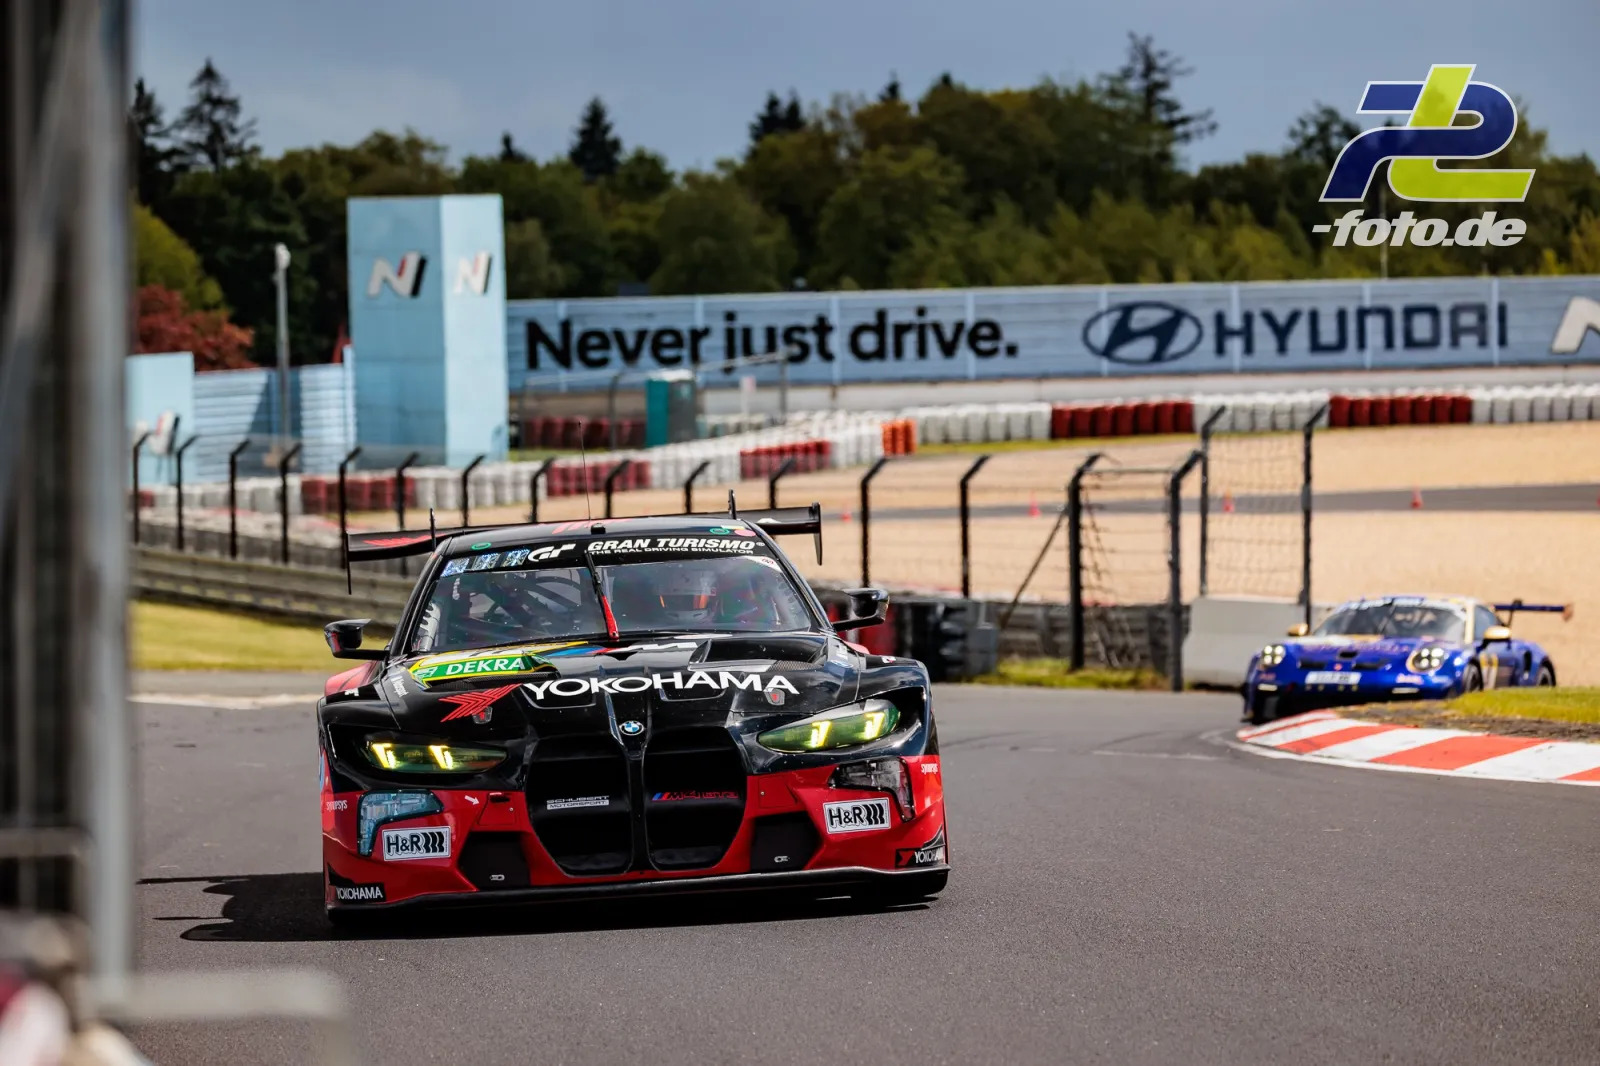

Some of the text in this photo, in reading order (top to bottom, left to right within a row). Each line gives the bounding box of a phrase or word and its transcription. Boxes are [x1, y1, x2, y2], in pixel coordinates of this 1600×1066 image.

[1214, 301, 1509, 357] HYUNDAI
[525, 306, 1018, 374] Never just drive.
[588, 538, 651, 550] GRAN
[690, 547, 754, 555] SIMULATOR
[446, 658, 526, 675] DEKRA
[523, 671, 800, 700] YOKOHAMA
[546, 795, 609, 804] SCHUBERT
[548, 800, 608, 809] MOTORSPORT
[828, 806, 864, 827] H&R
[386, 833, 422, 854] H&R
[336, 886, 383, 900] YOKOHAMA
